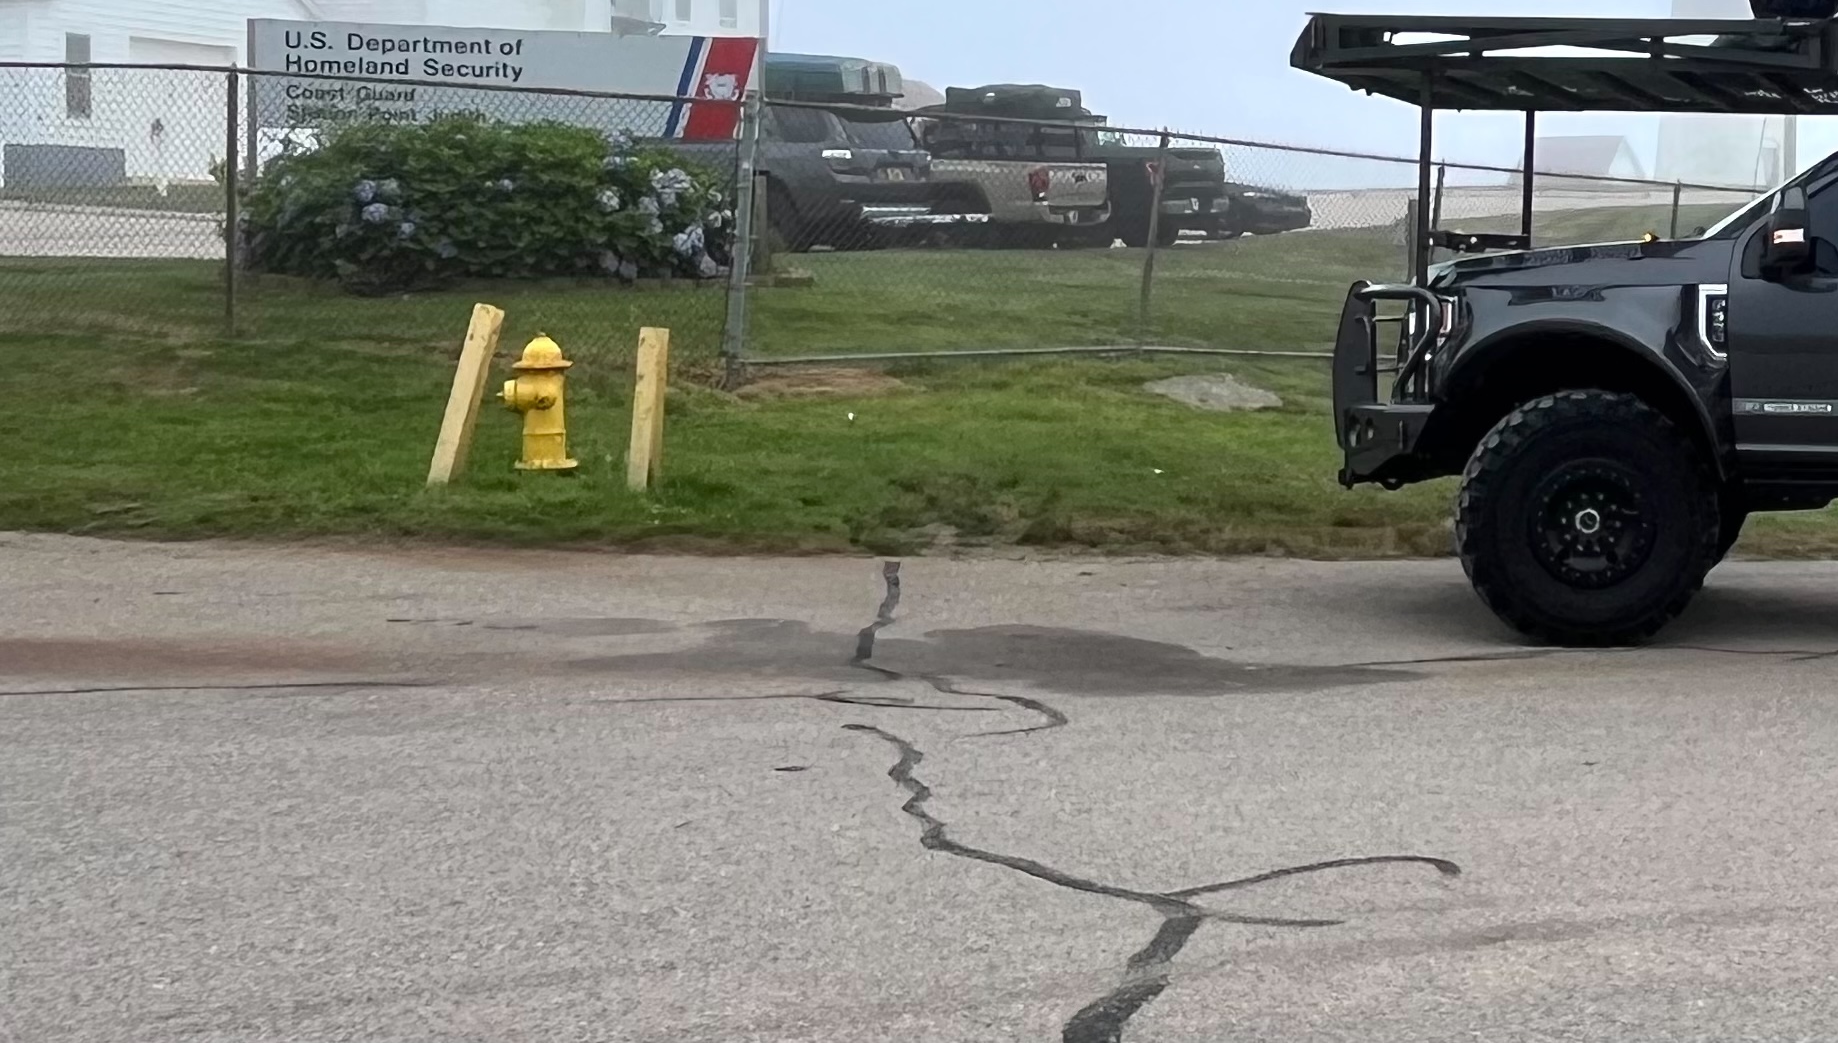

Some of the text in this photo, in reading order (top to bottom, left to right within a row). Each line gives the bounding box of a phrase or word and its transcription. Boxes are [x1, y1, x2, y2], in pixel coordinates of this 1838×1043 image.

[285, 30, 522, 56] U.S. Department of
[286, 54, 523, 82] Homeland Security
[286, 84, 345, 102] Coast
